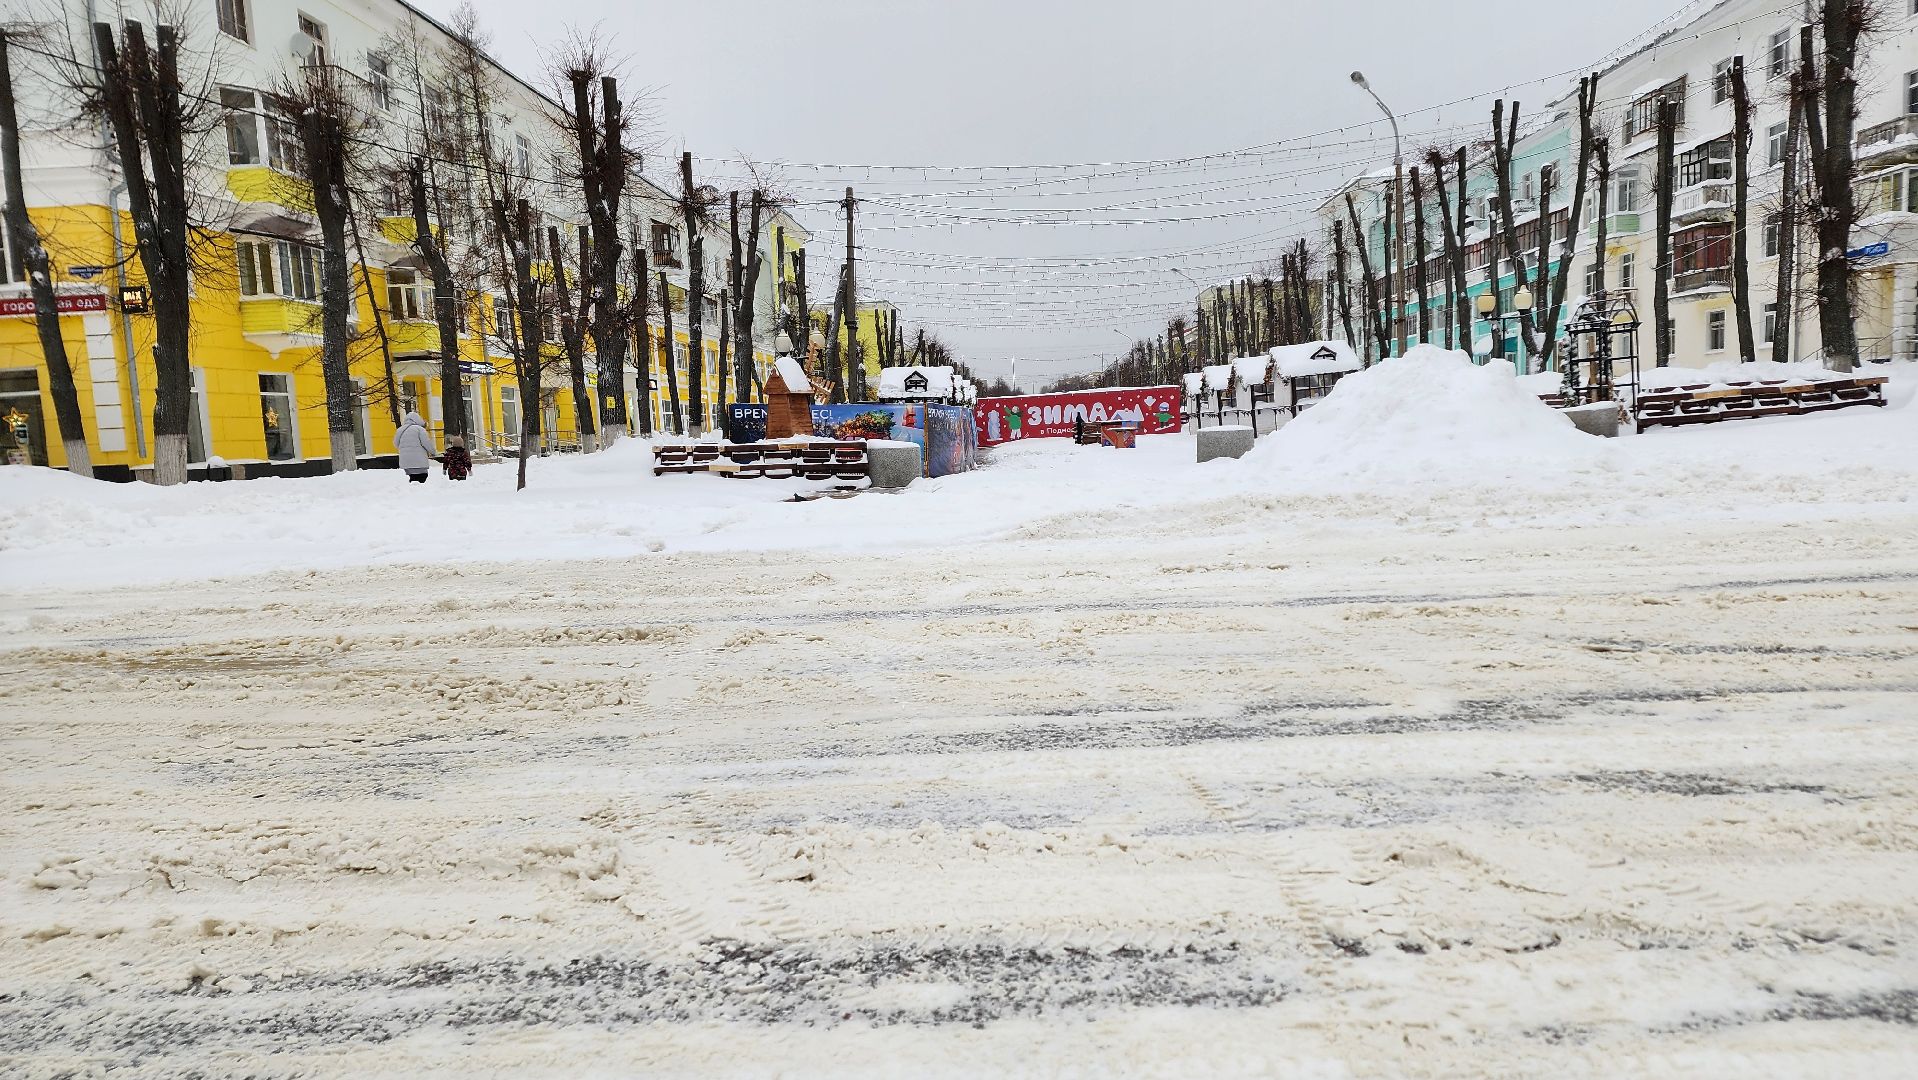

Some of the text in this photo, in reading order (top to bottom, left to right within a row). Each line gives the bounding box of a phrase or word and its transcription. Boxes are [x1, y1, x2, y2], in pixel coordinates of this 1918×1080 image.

[3, 298, 100, 313] гороая еда
[811, 409, 833, 419] ЕС!
[1027, 402, 1108, 425] ЗИМА
